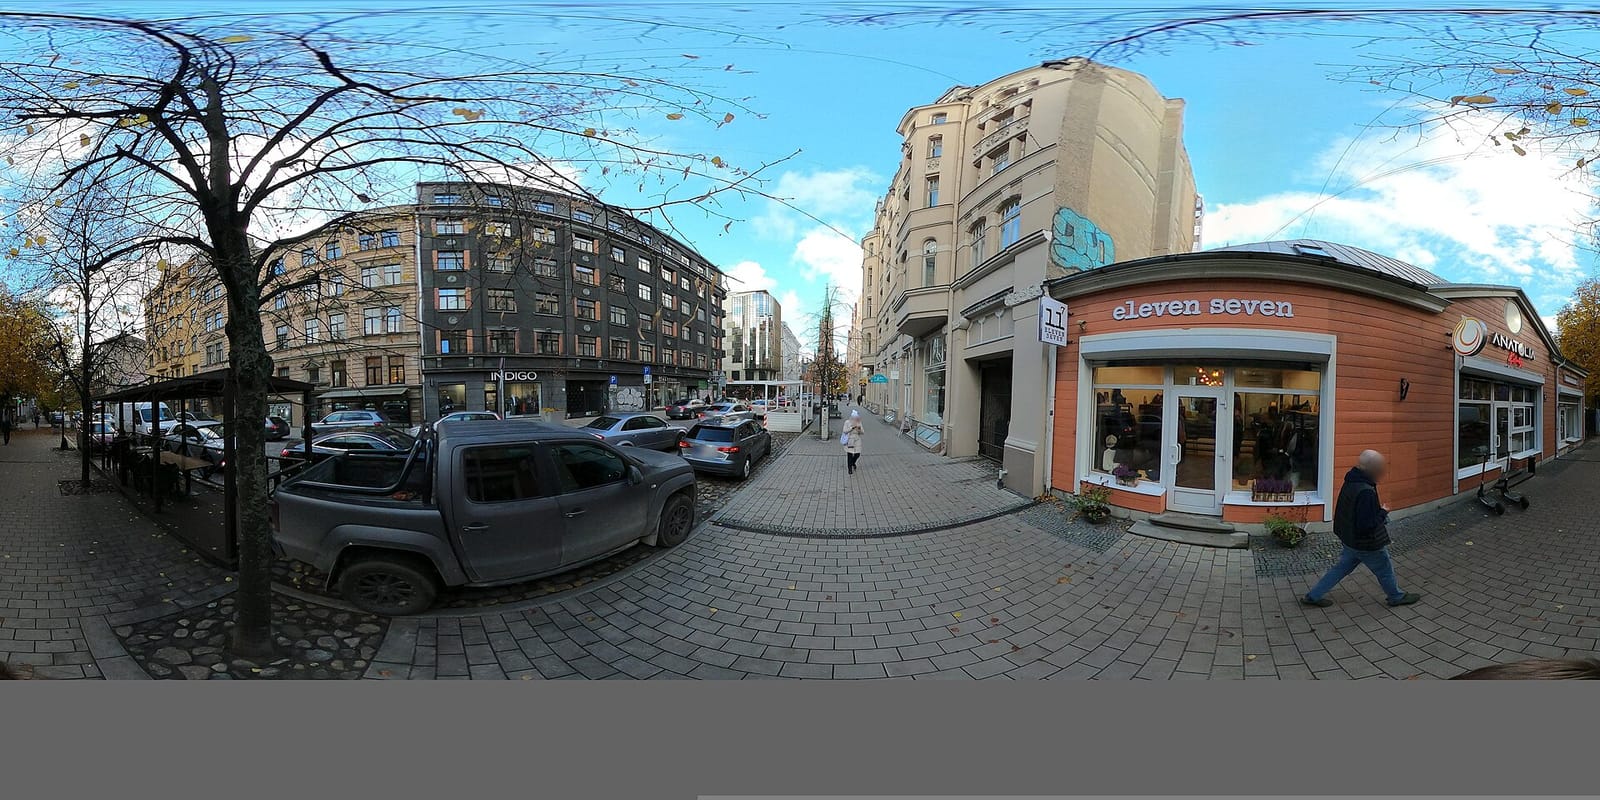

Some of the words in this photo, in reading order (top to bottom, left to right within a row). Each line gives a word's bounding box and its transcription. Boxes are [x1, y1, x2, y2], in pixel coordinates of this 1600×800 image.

[1112, 298, 1201, 321] eleven
[1210, 298, 1294, 318] seven
[1044, 327, 1065, 337] ELEVEN
[1492, 332, 1536, 361] ANATOLIA
[490, 371, 538, 381] INDIGO
